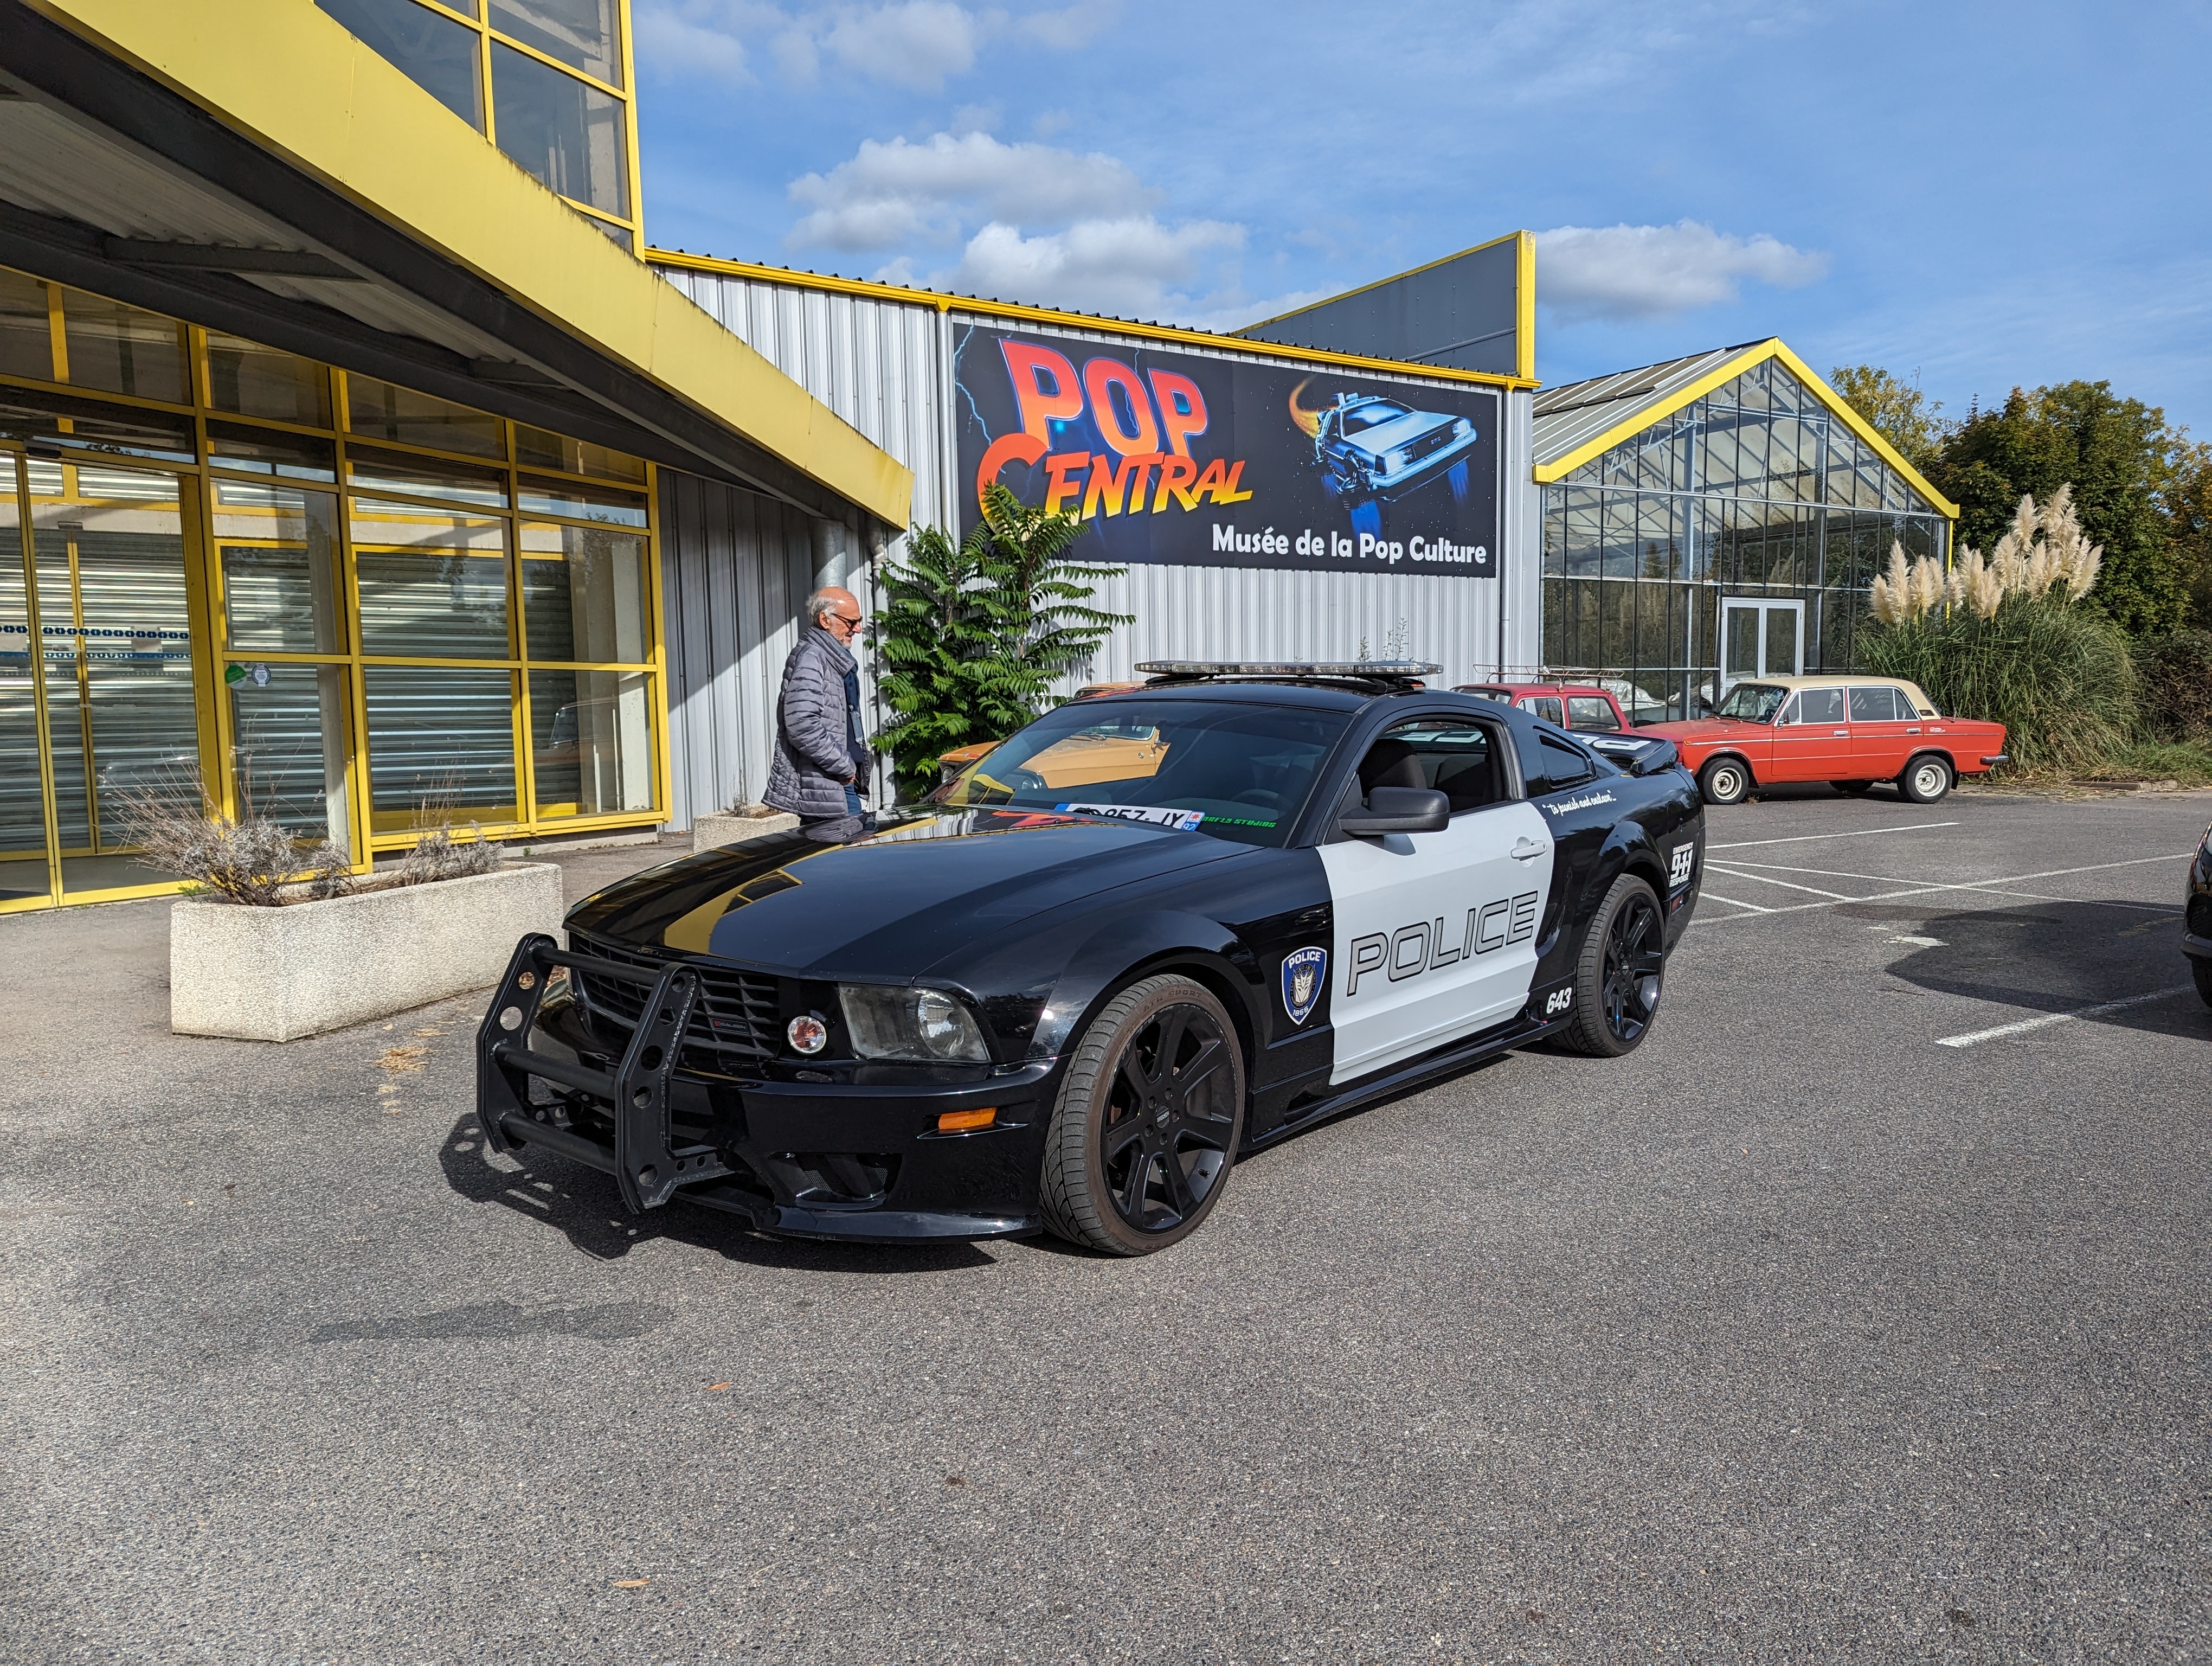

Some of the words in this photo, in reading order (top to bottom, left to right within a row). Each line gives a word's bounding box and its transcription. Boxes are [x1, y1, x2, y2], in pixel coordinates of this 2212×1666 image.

[999, 338, 1208, 459] POP
[977, 433, 1253, 542] CENTRAL
[1212, 523, 1289, 555] Musée
[1295, 529, 1324, 556] de
[1331, 531, 1352, 558] la
[1359, 533, 1403, 565] Pop
[1409, 536, 1487, 564] Culture
[1558, 797, 1580, 817] punish
[1579, 795, 1592, 808] and
[1288, 951, 1321, 969] POLICE
[1347, 890, 1538, 997] POLICE
[1168, 989, 1202, 998] SPORT
[1546, 987, 1572, 1014] 643
